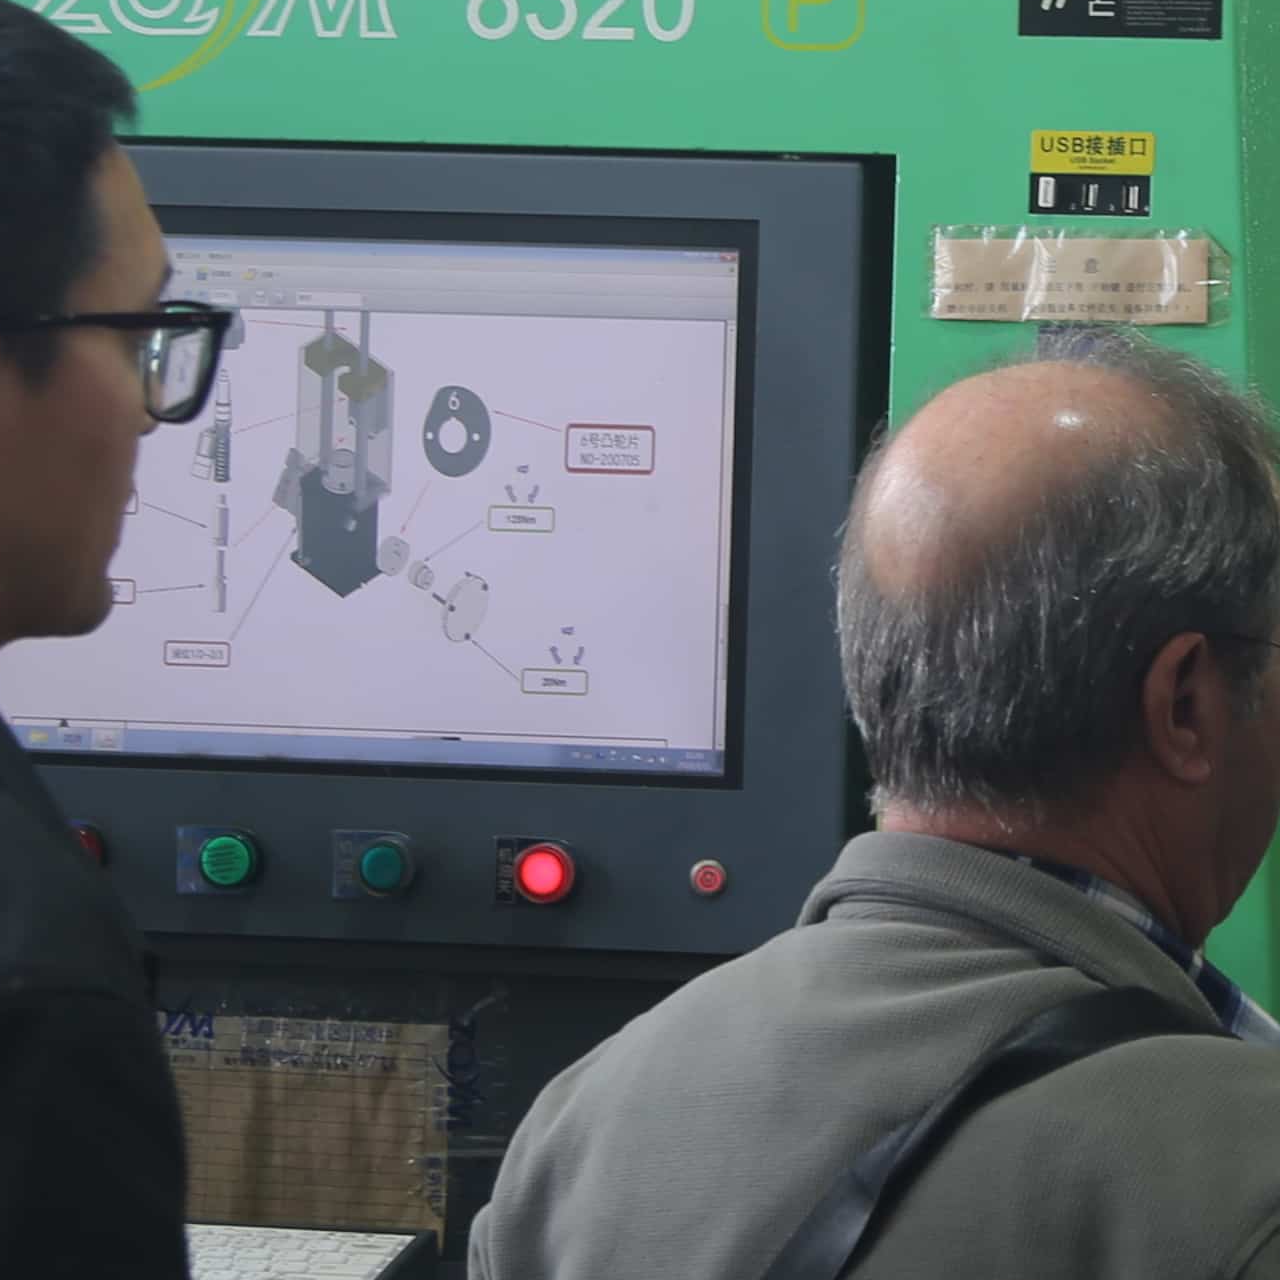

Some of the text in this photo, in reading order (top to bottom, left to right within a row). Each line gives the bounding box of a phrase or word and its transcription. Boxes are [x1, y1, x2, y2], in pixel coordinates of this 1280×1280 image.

[1040, 135, 1148, 156] USB接插口
[447, 391, 460, 410] 6
